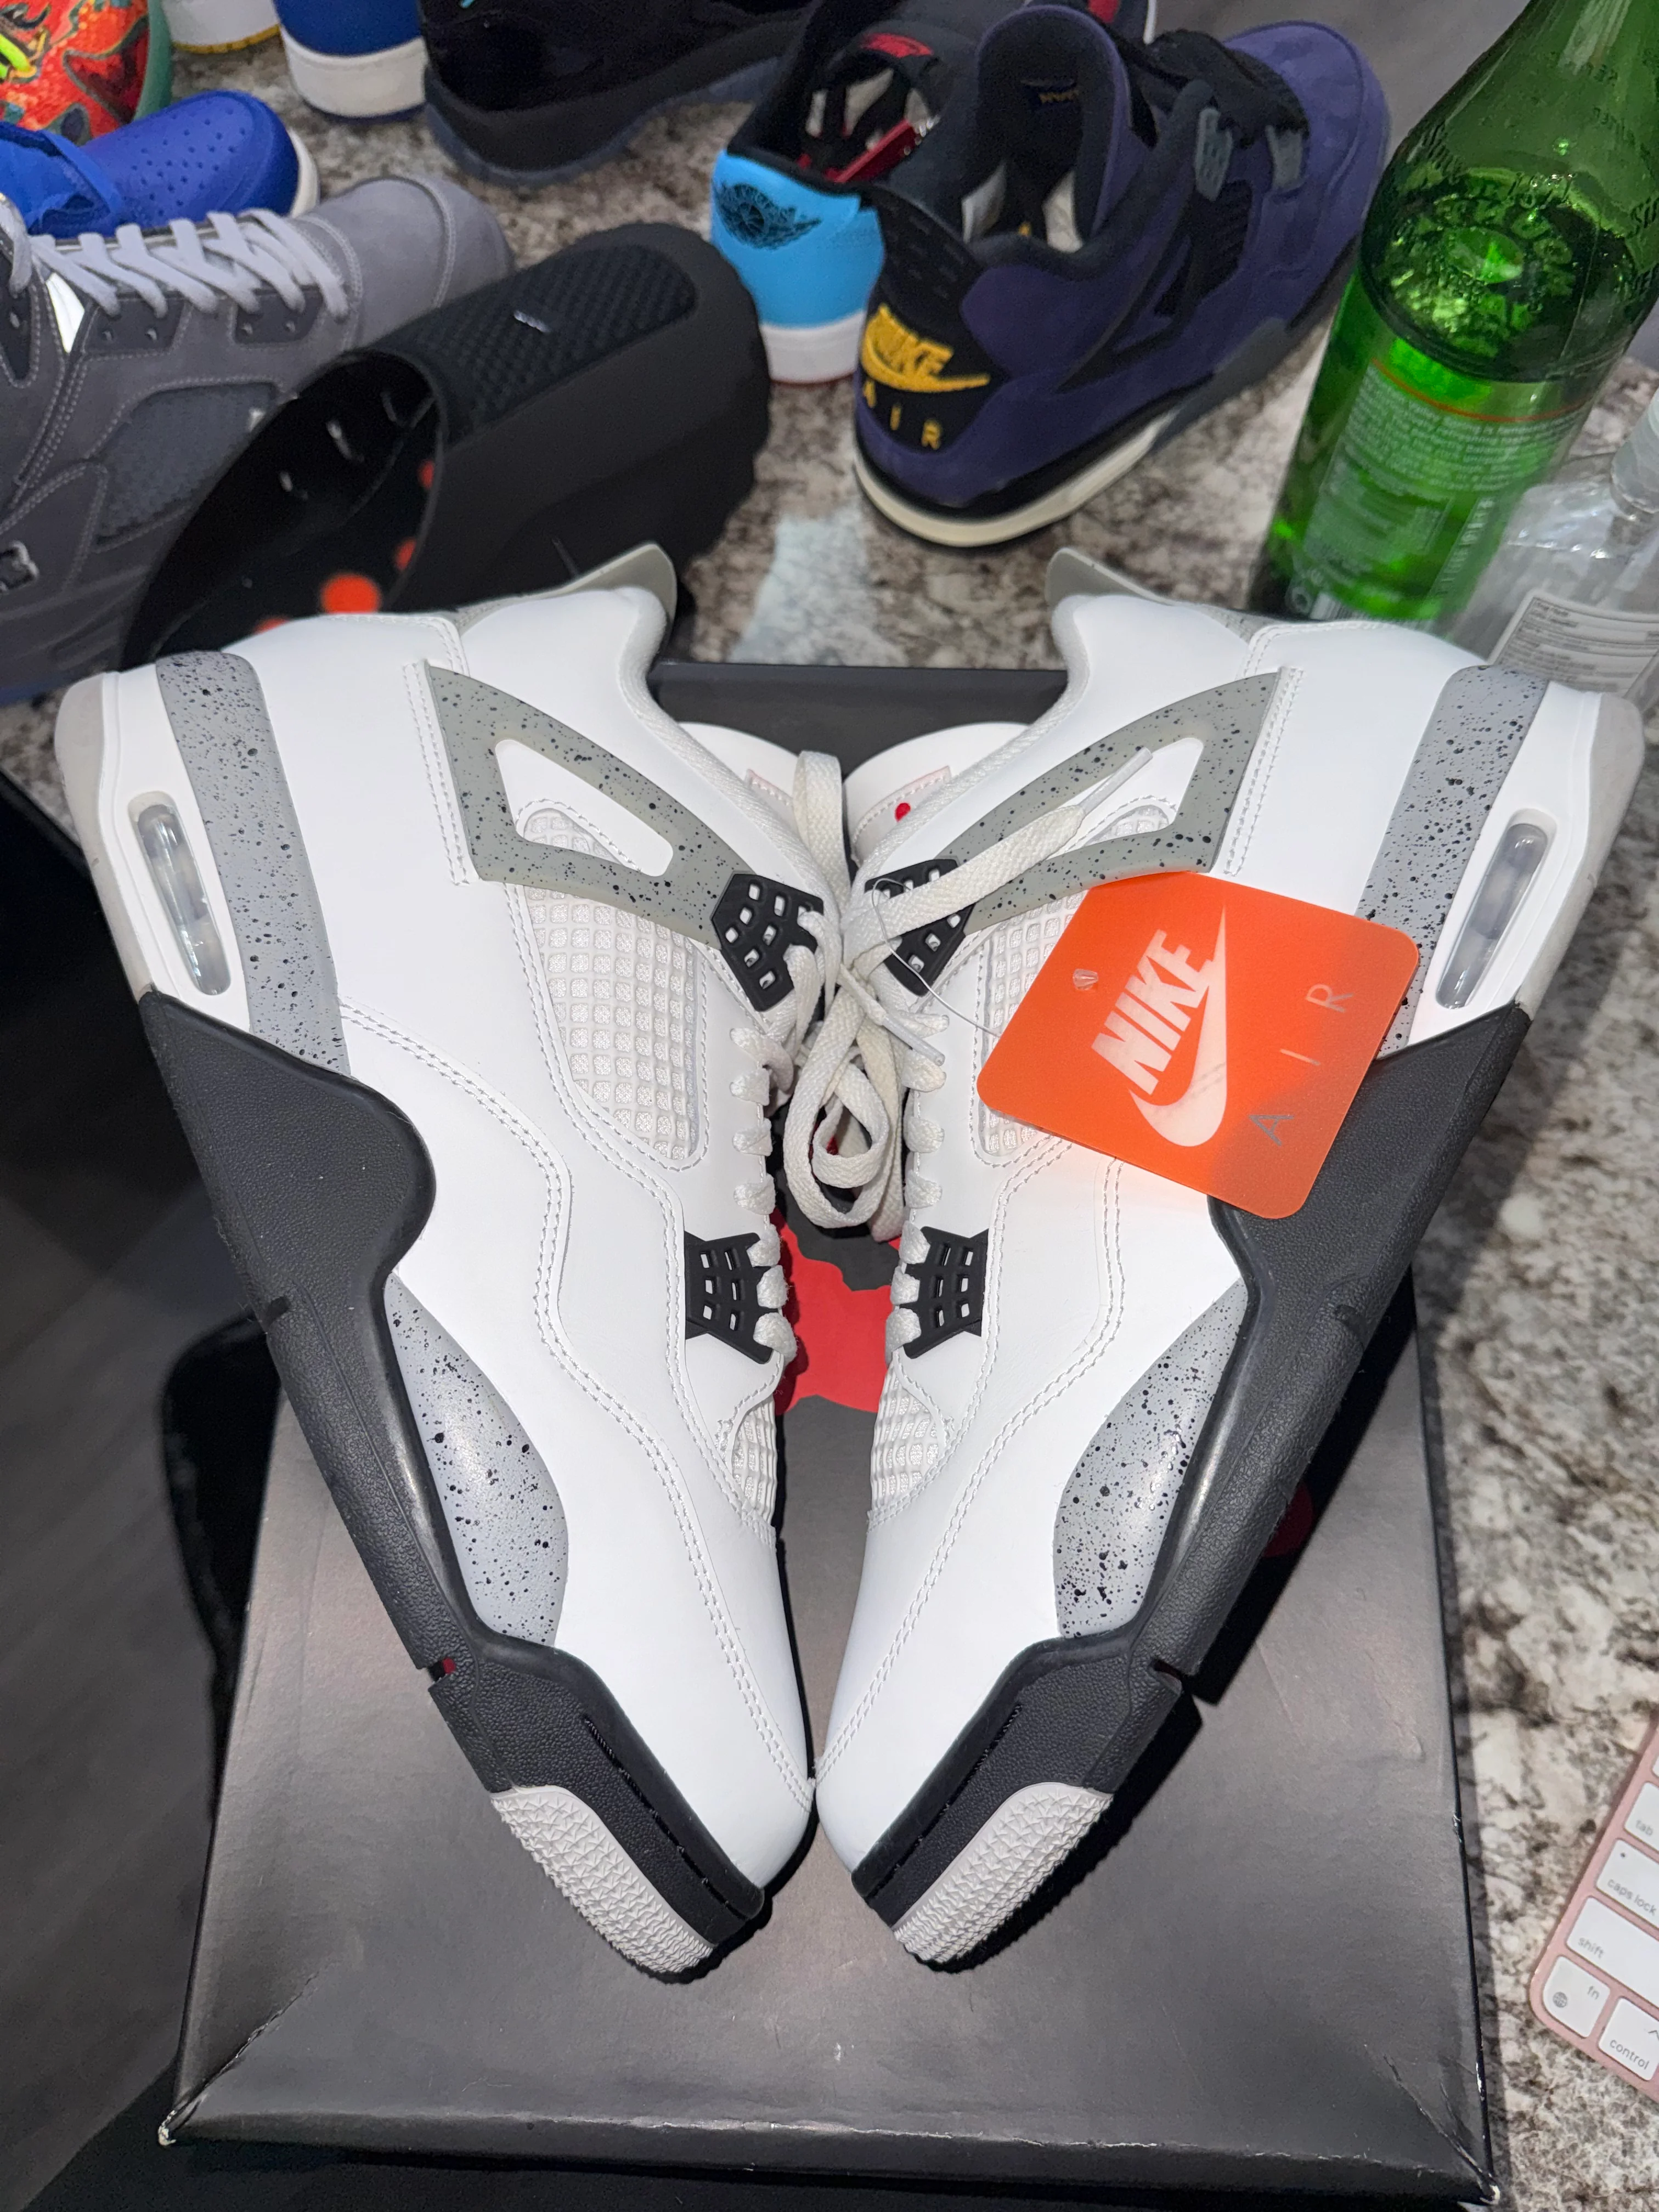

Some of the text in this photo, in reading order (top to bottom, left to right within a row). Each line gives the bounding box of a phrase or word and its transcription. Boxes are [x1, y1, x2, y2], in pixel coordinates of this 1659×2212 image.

[1091, 929, 1215, 1096] NIKE
[1635, 1819, 1654, 1836] tab
[1607, 1878, 1657, 1916] caps lock
[1577, 1937, 1605, 1959] shift
[1587, 1985, 1600, 2000] fn
[1610, 2039, 1650, 2070] control
